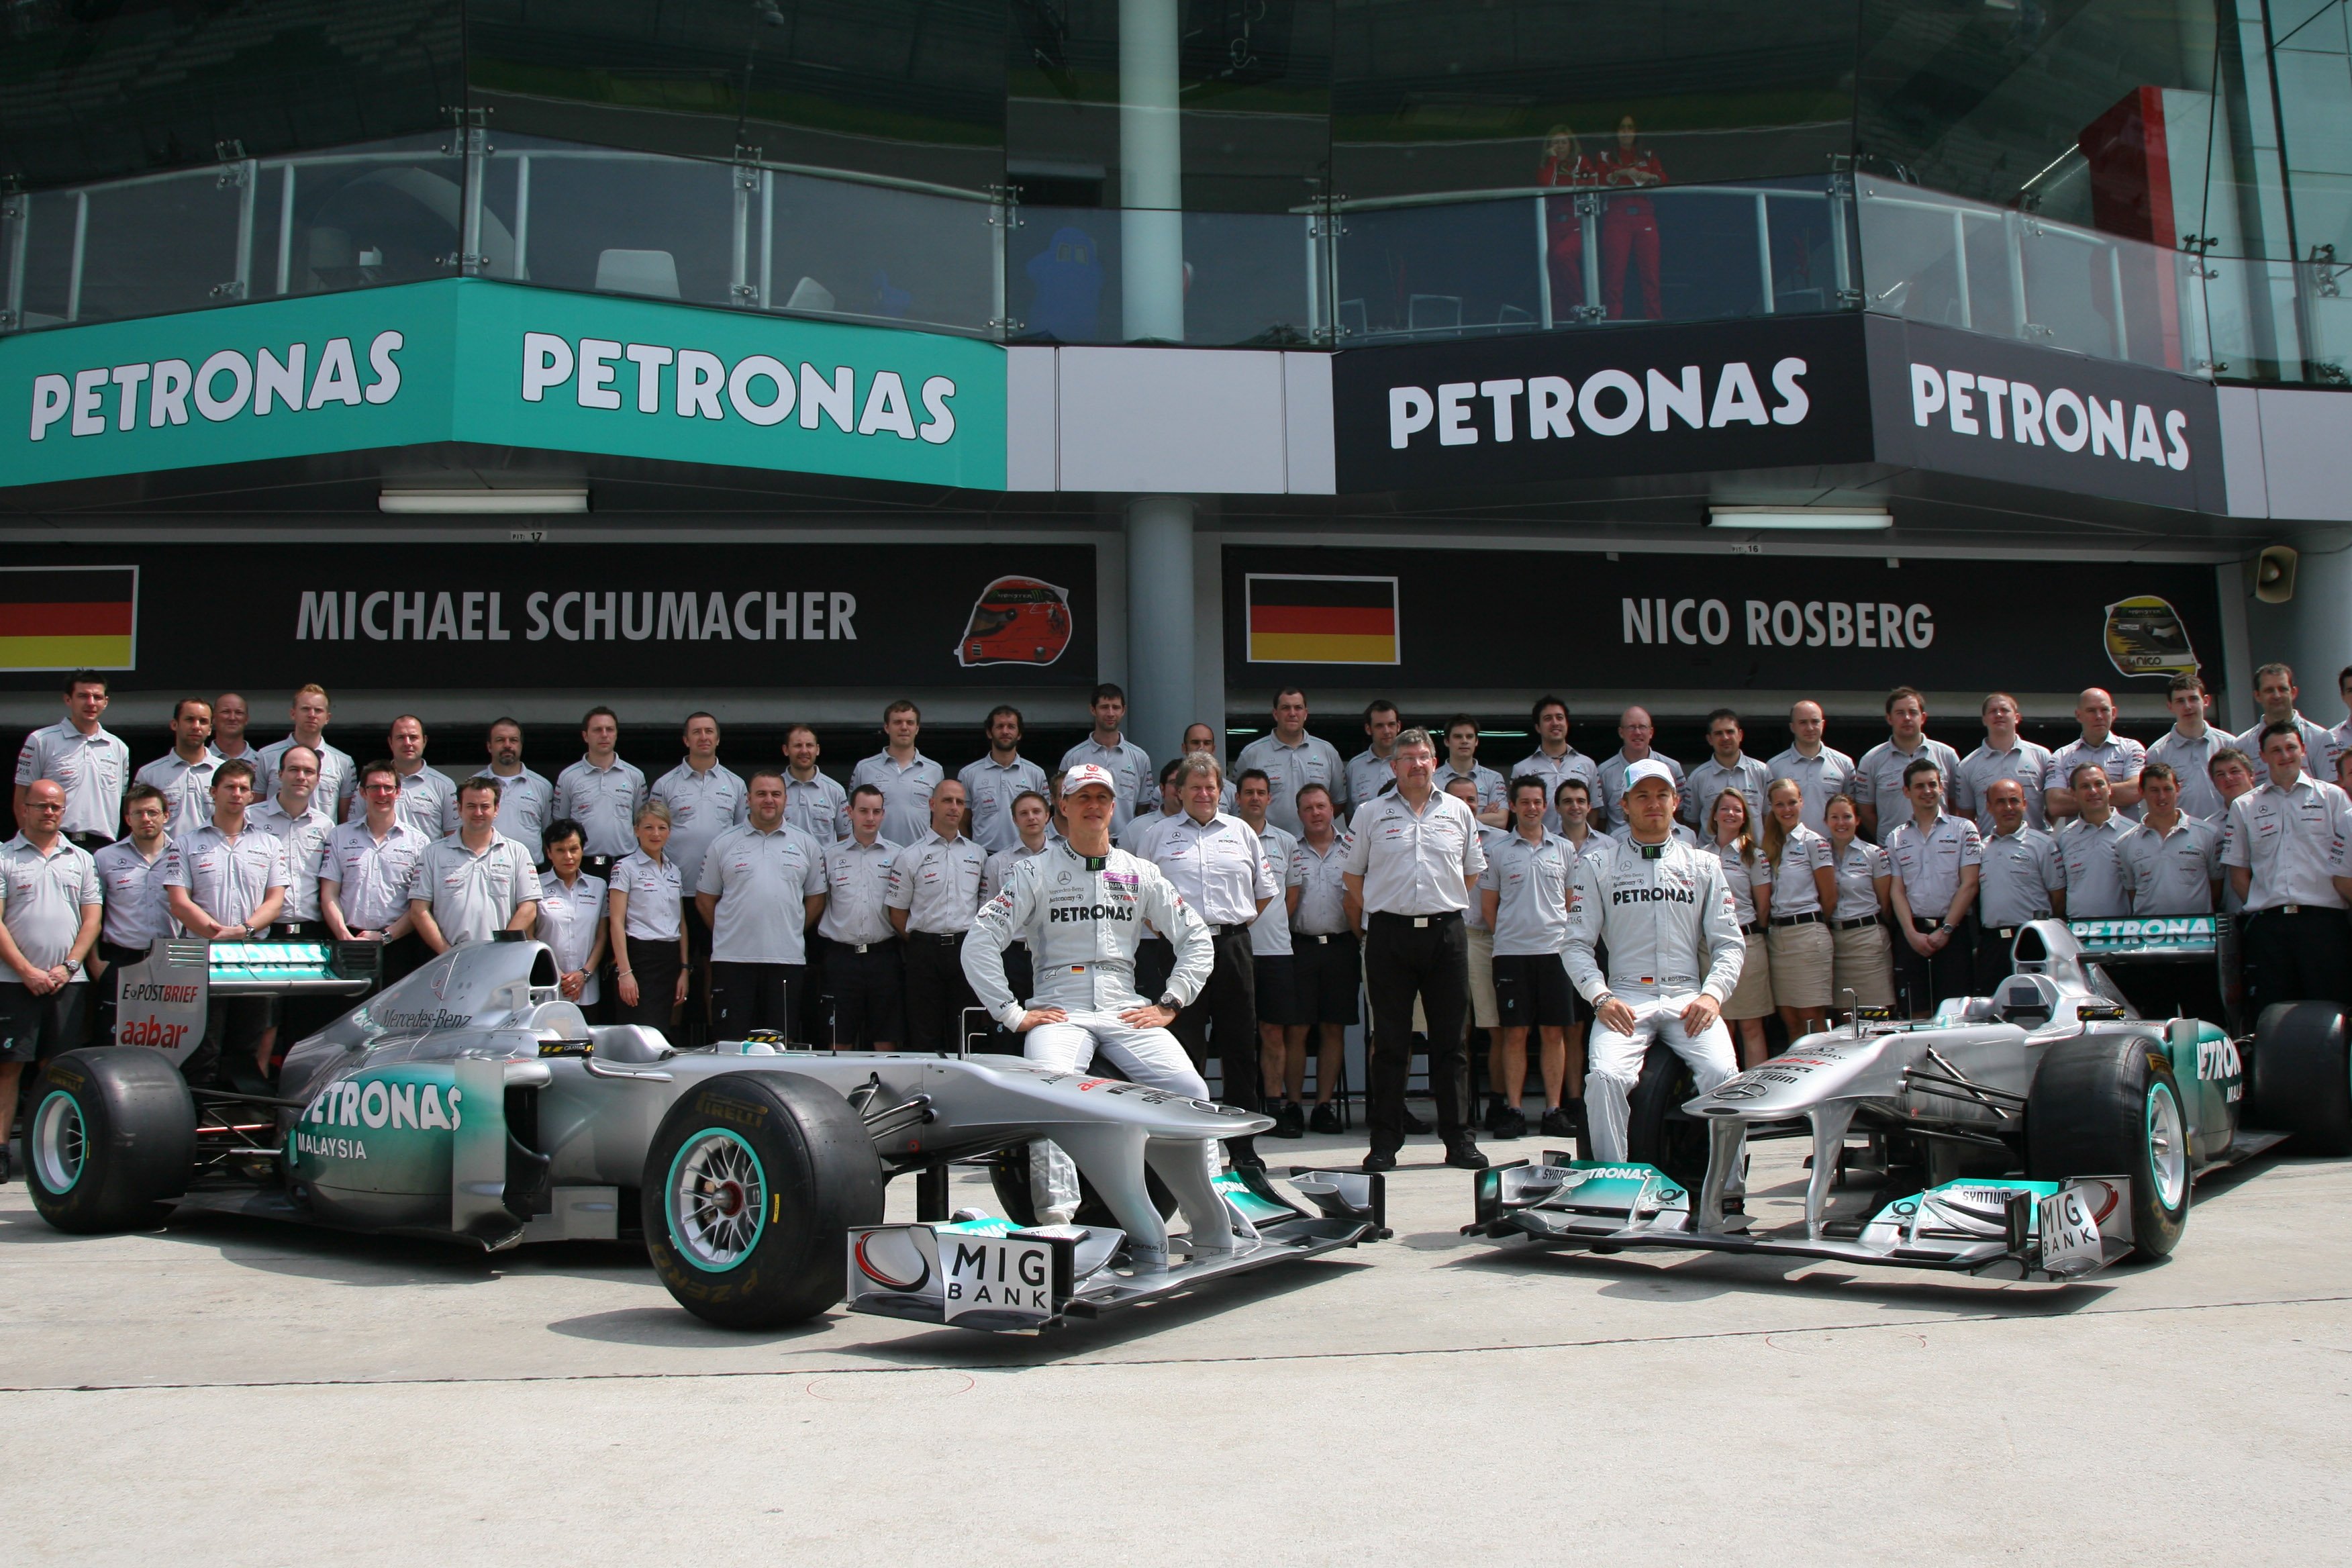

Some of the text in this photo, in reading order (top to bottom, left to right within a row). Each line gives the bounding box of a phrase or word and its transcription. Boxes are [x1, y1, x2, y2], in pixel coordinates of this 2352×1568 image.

[30, 330, 404, 442] PETRONAS
[521, 331, 956, 444] PETRONAS
[1389, 357, 1810, 449] PETRONAS
[1910, 362, 2190, 471] PETRONAS
[530, 532, 542, 540] 17
[296, 591, 857, 641] MICHAEL SCHUMACHER
[1622, 597, 1934, 649] NICO ROSBERG
[1613, 887, 1695, 905] PETRONAS
[1050, 904, 1133, 923] PETRONAS
[2071, 919, 2215, 945] PETRONA
[120, 1014, 189, 1049] aabar
[380, 1009, 473, 1028] Mercedes-Benz
[297, 1132, 367, 1160] MALAYSIA
[1963, 1191, 2012, 1204] SYNTIUM
[2042, 1193, 2084, 1237] MIG
[2043, 1227, 2098, 1257] BANK
[951, 1242, 1045, 1287] MIG
[947, 1282, 1047, 1309] BANK
